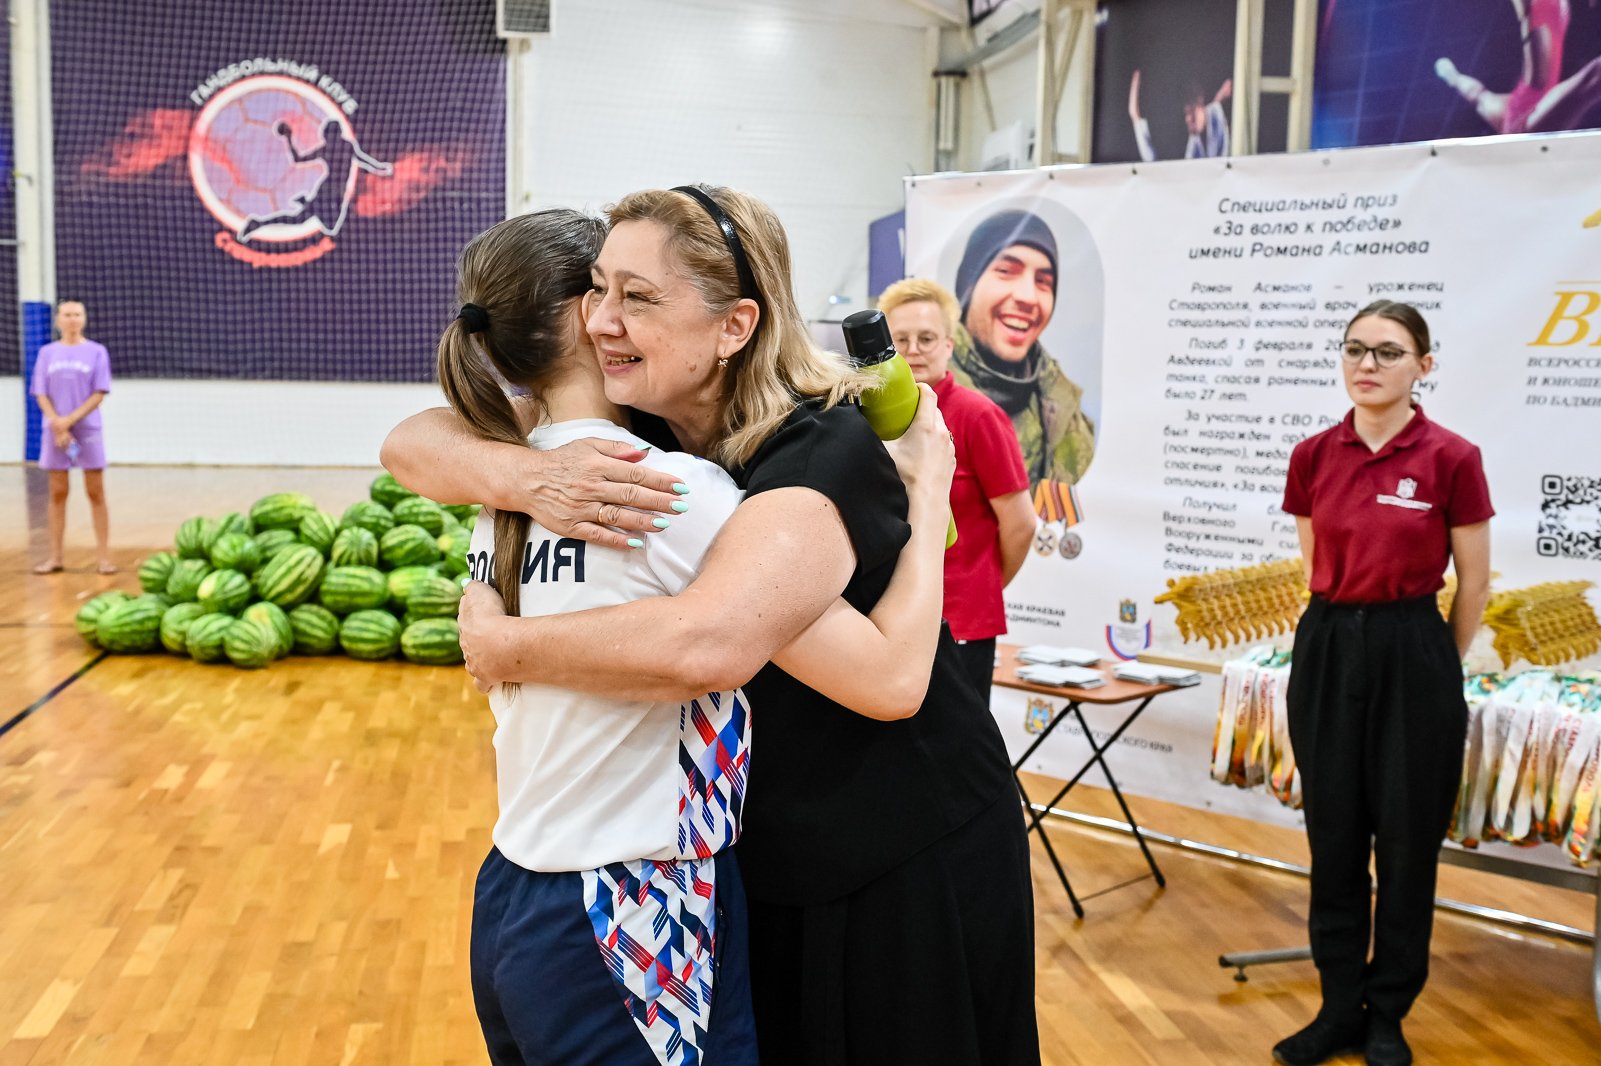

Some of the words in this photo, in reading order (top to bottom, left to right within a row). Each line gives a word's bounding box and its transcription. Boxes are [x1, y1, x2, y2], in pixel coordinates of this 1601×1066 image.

[190, 57, 319, 106] ГАНДБОЛЬНЫЙ
[318, 74, 359, 115] КЛУБ
[1218, 193, 1347, 214] Специальный
[1353, 193, 1399, 212] приз
[1213, 220, 1243, 236] «За
[1250, 221, 1298, 236] волю
[1304, 221, 1314, 234] к
[1321, 215, 1402, 234] победе»
[1188, 245, 1244, 260] имени
[1250, 241, 1323, 258] Романа
[1328, 239, 1430, 257] Асманова
[1191, 282, 1232, 294] Роман
[1253, 281, 1313, 294] Асманов
[1368, 281, 1445, 296] уроженец
[1259, 298, 1317, 312] военный
[1324, 300, 1357, 313] врач
[1167, 315, 1250, 330] специальной
[1254, 315, 1310, 329] военной
[1527, 290, 1601, 347] В
[1188, 337, 1228, 351] Погиб
[1237, 338, 1245, 351] 3
[1254, 338, 1314, 353] февраля
[1166, 354, 1233, 369] Авдеевкой
[1245, 357, 1265, 369] от
[1278, 356, 1337, 371] снаряда
[1214, 373, 1261, 386] спасая
[1527, 375, 1538, 388] И
[1164, 388, 1196, 401] было
[1200, 388, 1215, 401] 27
[1525, 394, 1548, 406] ПО
[1185, 409, 1200, 422] За
[1206, 412, 1263, 425] участие
[1281, 413, 1313, 427] СВО
[1163, 424, 1189, 438] был
[1199, 430, 1272, 443] награжден
[1164, 460, 1222, 473] спасение
[1182, 496, 1238, 512] Получил
[1162, 511, 1236, 529] Верховного
[1164, 527, 1264, 547] Вооруженными
[1164, 543, 1234, 562] Федерации
